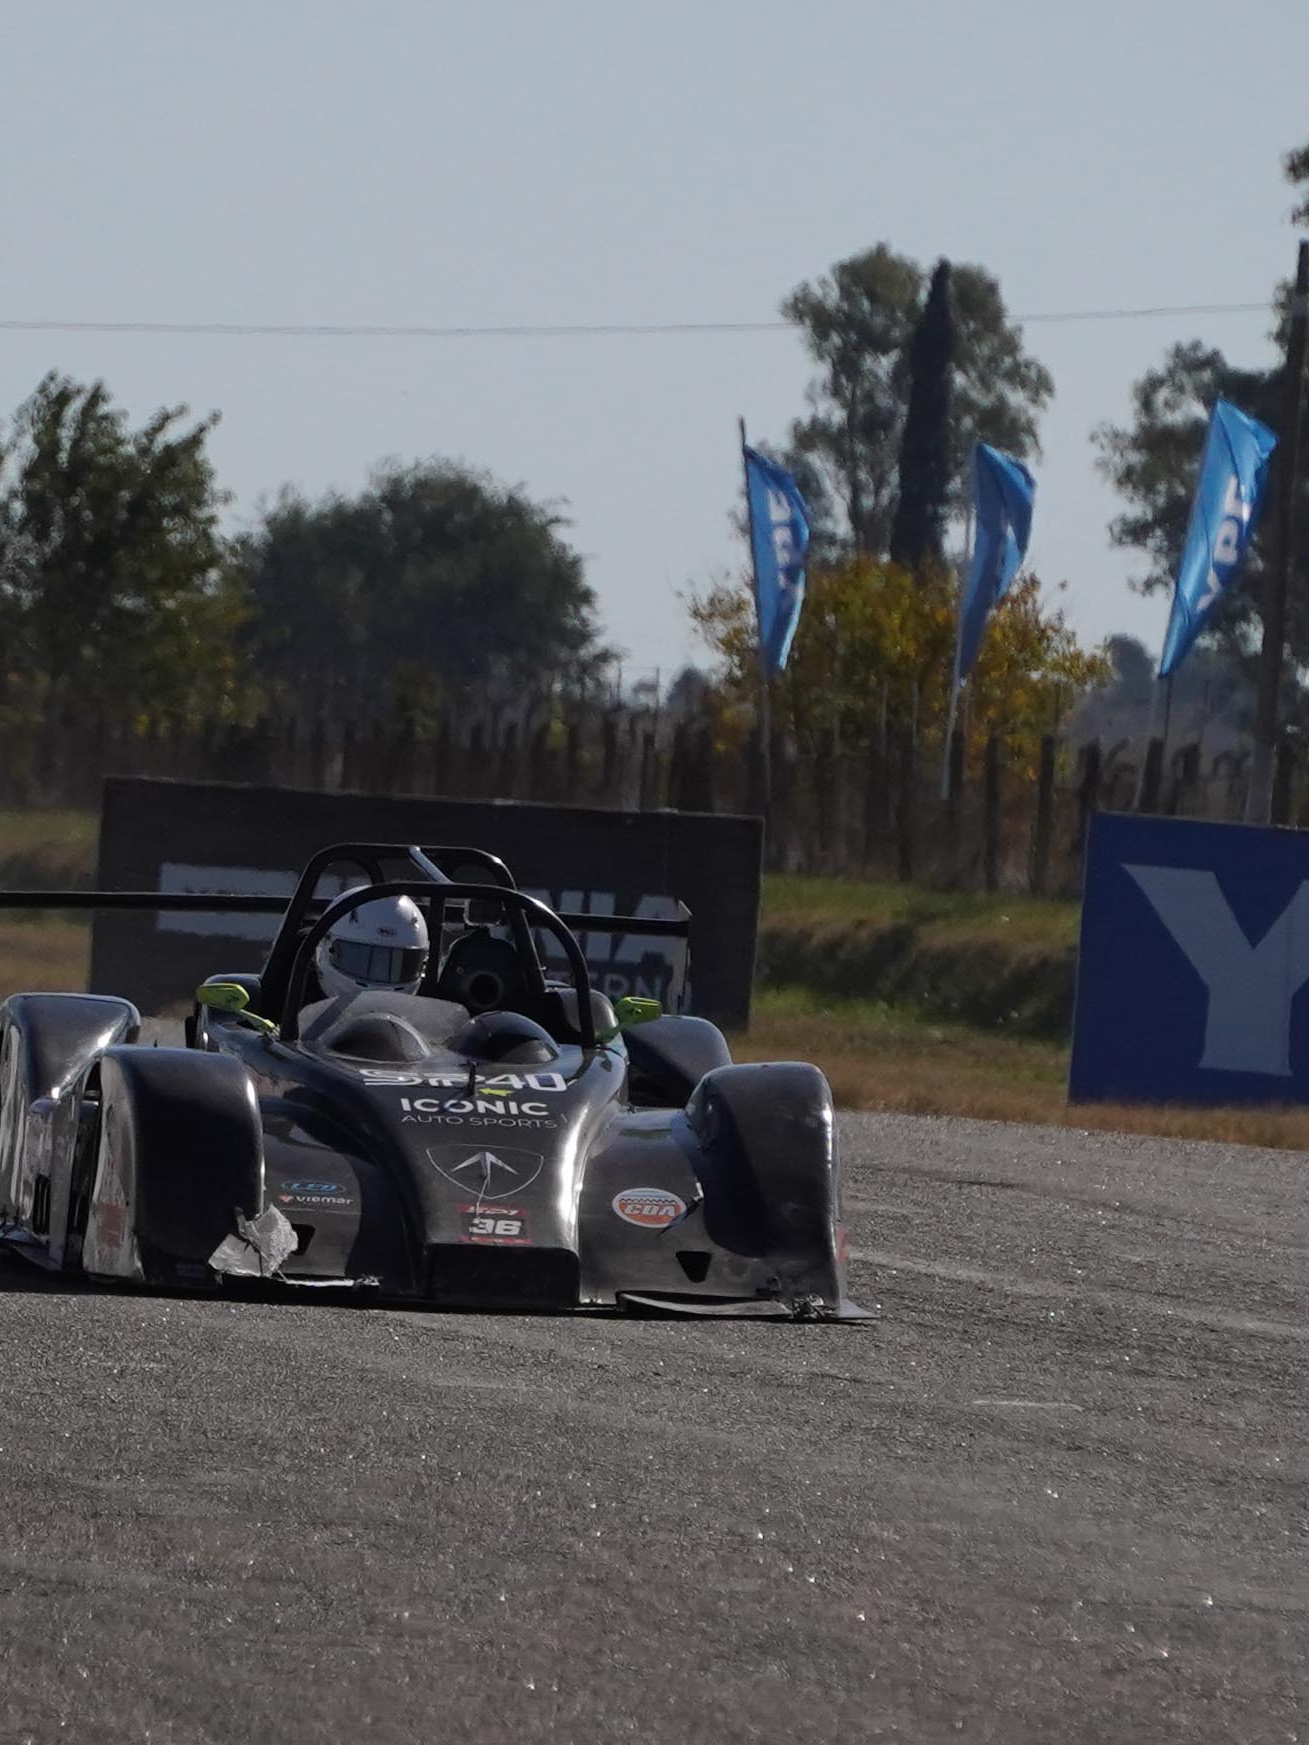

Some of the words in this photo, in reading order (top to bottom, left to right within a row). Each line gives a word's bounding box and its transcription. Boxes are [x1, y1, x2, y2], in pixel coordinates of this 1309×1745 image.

[400, 1098, 549, 1116] ICONIC
[468, 1116, 558, 1129] SPORTS
[468, 1218, 522, 1235] 36
